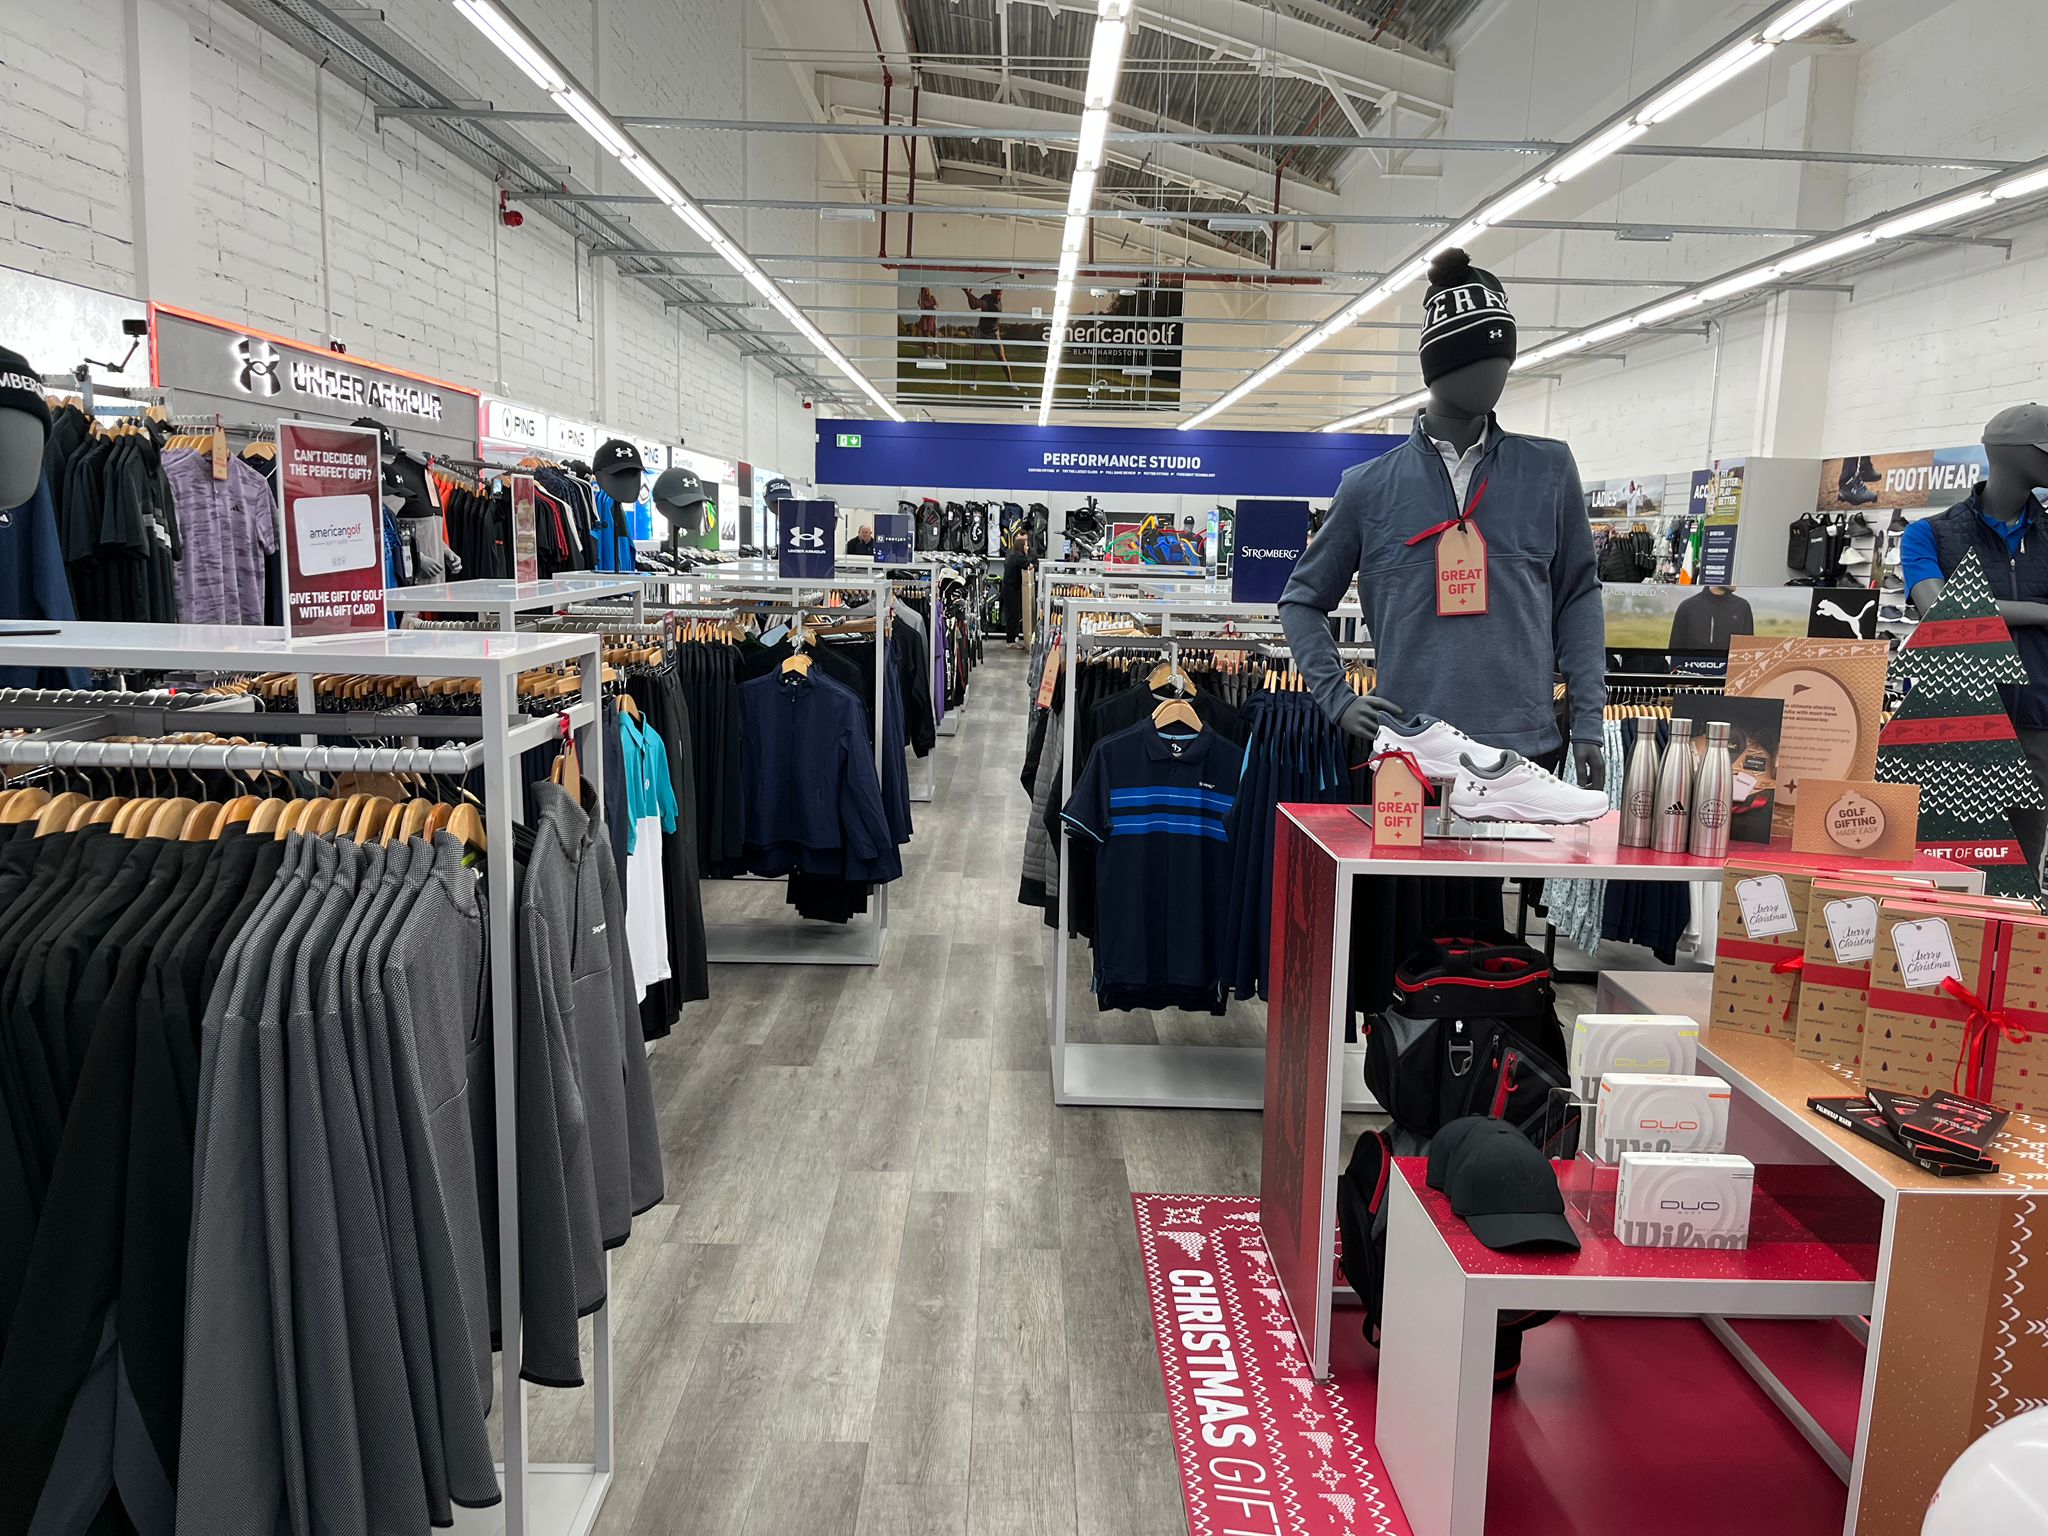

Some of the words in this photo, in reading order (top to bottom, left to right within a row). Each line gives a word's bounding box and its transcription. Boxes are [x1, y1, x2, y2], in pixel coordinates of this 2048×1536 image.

[291, 361, 365, 405] UNDER
[367, 380, 443, 421] ARMOUR
[514, 416, 535, 437] PING
[568, 429, 585, 447] PING
[294, 449, 321, 463] CAN'T
[322, 451, 354, 466] DECIDE
[354, 454, 367, 466] ON
[643, 445, 659, 464] PING
[1043, 452, 1147, 468] PERFORMANCE
[1149, 456, 1201, 470] STUDIO
[289, 463, 308, 476] THE
[309, 465, 347, 479] PERFECT
[348, 467, 372, 480] GIFT?
[1884, 463, 1981, 493] FOOTWEAR
[1592, 490, 1617, 507] LADIES
[309, 523, 361, 539] americangolf
[1224, 519, 1232, 547] PING
[1241, 545, 1298, 560] STROMBERG
[1441, 569, 1482, 582] GREAT
[1448, 582, 1476, 595] GIFT
[1631, 588, 1657, 597] BOLD
[289, 591, 311, 605] GIVE
[311, 591, 330, 604] THE
[330, 590, 350, 603] GIFT
[350, 590, 362, 602] OF
[362, 589, 384, 601] GOLF
[299, 605, 325, 619] WITH
[325, 605, 333, 617] A
[333, 604, 352, 617] GIFT
[352, 603, 376, 616] CARD
[1377, 802, 1419, 814] GREAT
[1838, 806, 1867, 819] GOLF
[1384, 816, 1413, 828] GIFT
[1834, 816, 1876, 830] GIFTING
[1835, 828, 1857, 838] MADE
[1858, 825, 1878, 836] EASY
[1923, 848, 1953, 859] GIFT
[1955, 847, 1973, 859] OF
[1974, 847, 2009, 858] GOLF
[1749, 913, 1788, 925] Christmas
[1907, 960, 1951, 974] Christmas
[1615, 1057, 1670, 1069] DUO
[1639, 1119, 1698, 1130] DUO
[1660, 1200, 1720, 1211] DUO
[1624, 1219, 1748, 1250] Wilson
[1168, 1269, 1257, 1449] CHRISTMAS
